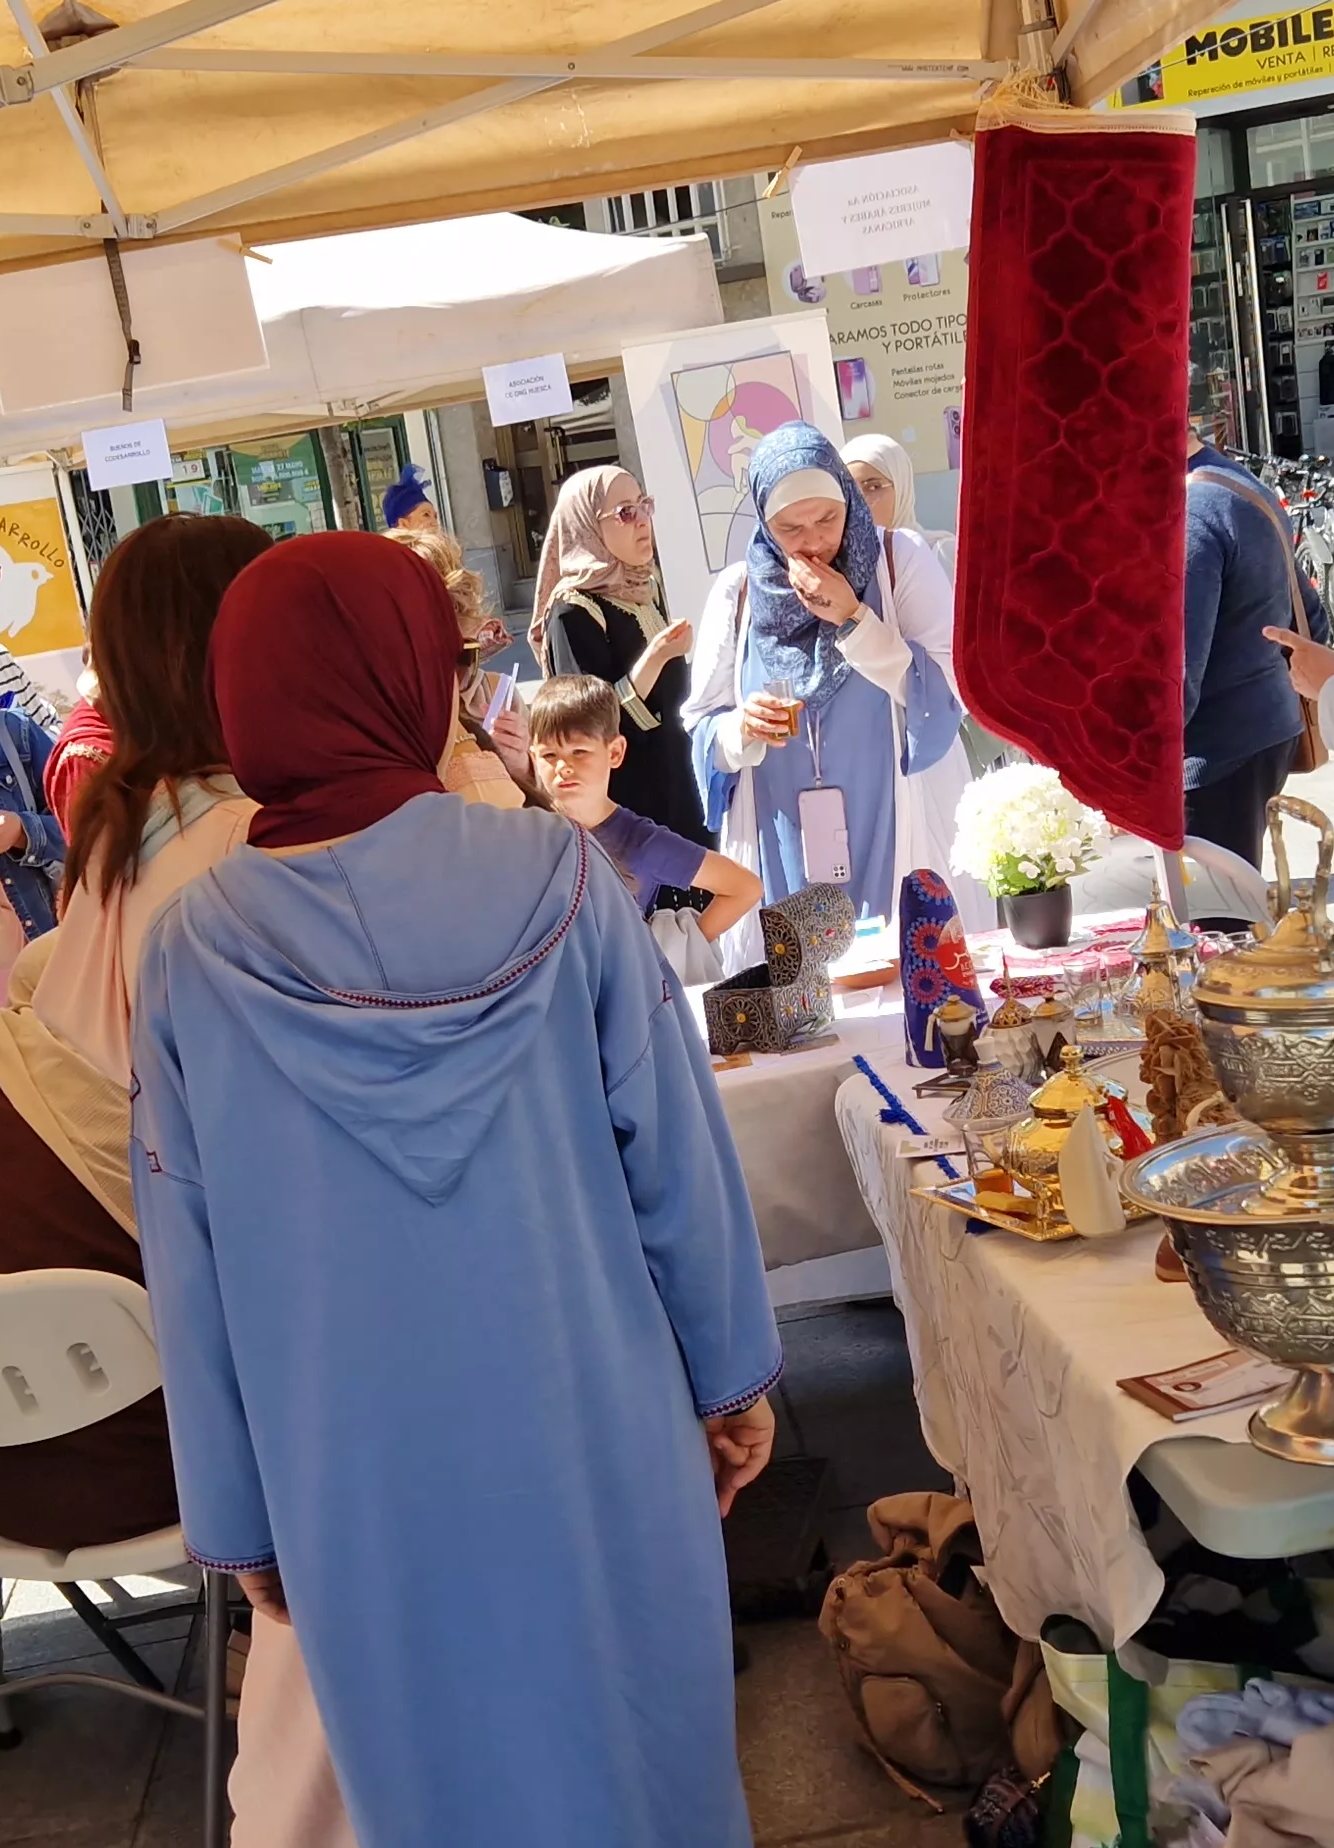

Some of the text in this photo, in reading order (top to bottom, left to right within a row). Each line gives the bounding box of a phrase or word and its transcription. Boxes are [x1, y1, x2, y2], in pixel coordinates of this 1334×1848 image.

[1184, 8, 1334, 66] MOBILE
[1256, 51, 1306, 70] VENTA
[1233, 81, 1243, 89] de
[1245, 74, 1276, 85] móviles
[1277, 74, 1282, 83] y
[1283, 66, 1324, 81] portátiles
[903, 288, 951, 302] Protectores
[890, 318, 933, 337] TODO
[882, 341, 892, 354] Y
[931, 386, 942, 395] de
